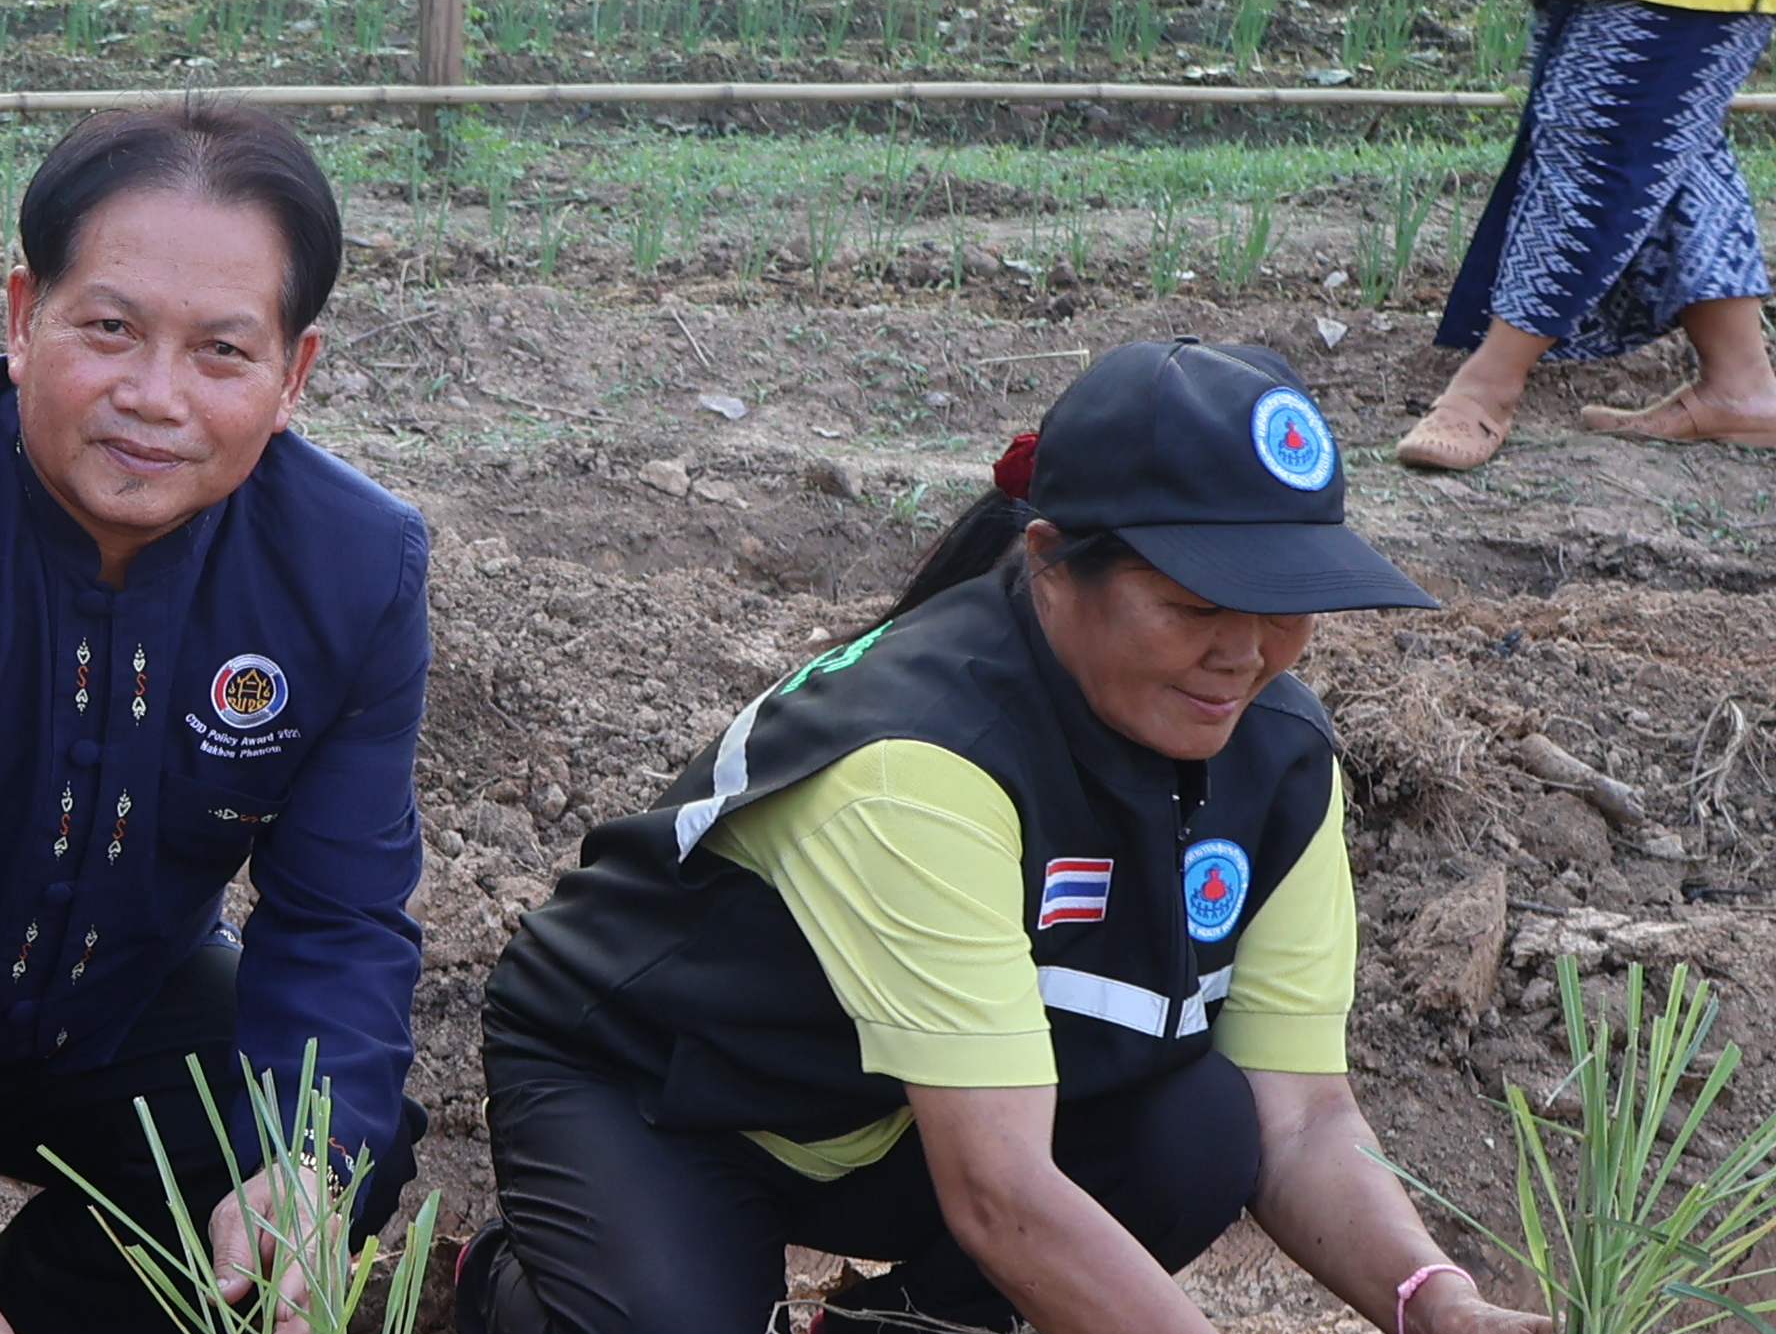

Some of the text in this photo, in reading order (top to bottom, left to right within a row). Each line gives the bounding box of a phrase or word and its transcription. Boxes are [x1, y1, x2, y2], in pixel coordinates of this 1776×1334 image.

[185, 713, 207, 734] CDD
[207, 729, 239, 746] Policy
[240, 732, 274, 746] Award
[200, 740, 281, 758] Nakhon Phanom
